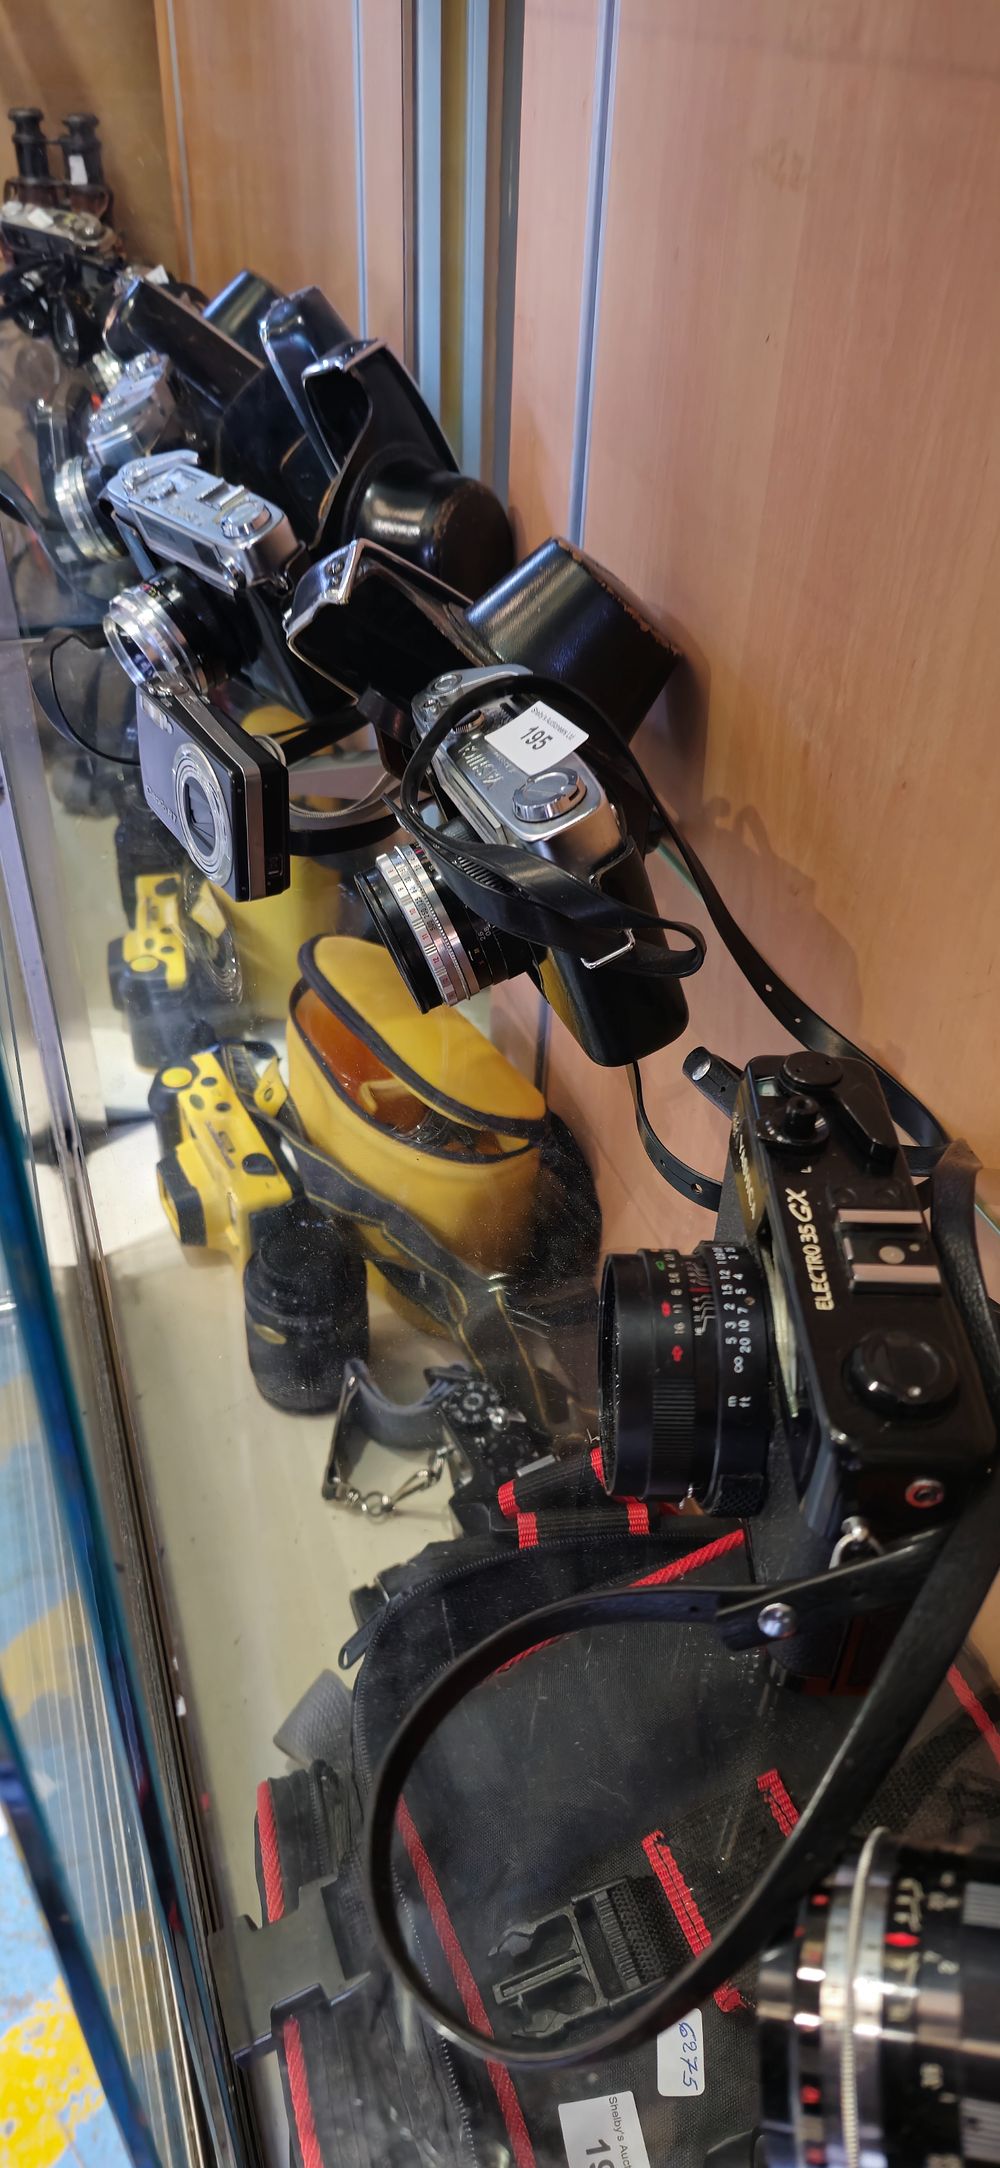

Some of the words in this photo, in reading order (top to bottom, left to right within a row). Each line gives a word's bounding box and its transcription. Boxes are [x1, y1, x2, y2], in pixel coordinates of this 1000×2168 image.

[520, 726, 553, 751] 195
[785, 1187, 813, 1223] GX
[798, 1224, 819, 1245] 35
[801, 1244, 835, 1311] ELECTRO
[734, 1287, 747, 1295] 5
[672, 1303, 682, 1314] 11
[723, 1303, 736, 1311] 2
[736, 1306, 749, 1315] 7
[674, 1321, 685, 1335] 16
[725, 1321, 737, 1330] 3
[738, 1319, 751, 1332] 10
[725, 1336, 738, 1345] 5
[739, 1336, 752, 1354] 20
[727, 1395, 738, 1408] m
[738, 1395, 752, 1408] ft
[678, 2022, 699, 2091] 6275
[608, 2096, 625, 2142] Shelby's
